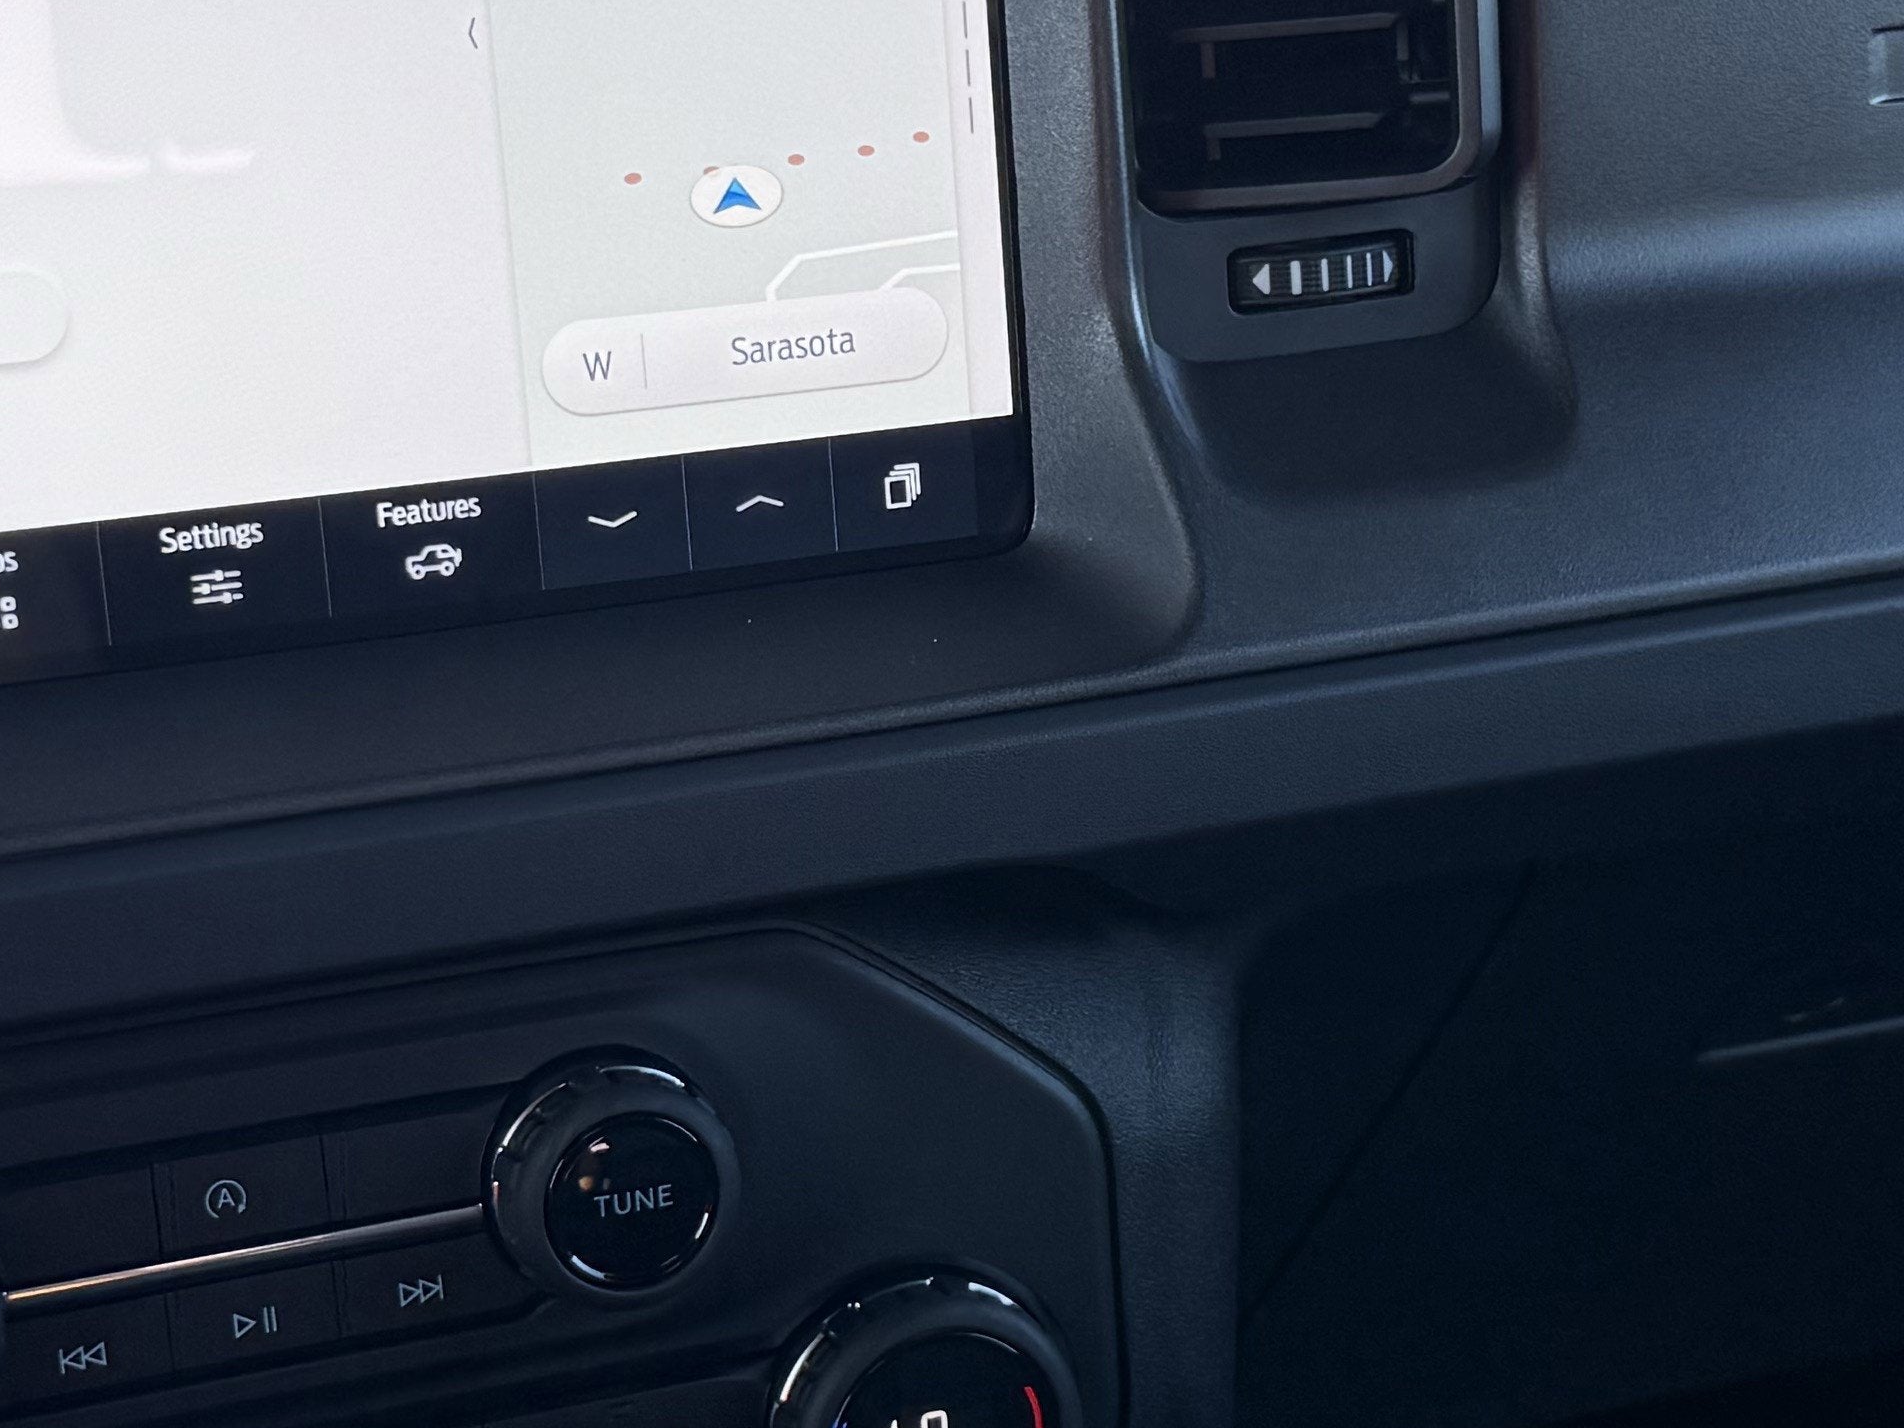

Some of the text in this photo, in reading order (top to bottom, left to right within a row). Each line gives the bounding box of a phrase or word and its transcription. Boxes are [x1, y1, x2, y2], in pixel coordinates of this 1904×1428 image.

[582, 349, 614, 383] W
[730, 327, 858, 367] Sarasota
[375, 492, 482, 531] Features
[157, 516, 265, 556] Settings
[592, 1182, 676, 1220] TUNE
